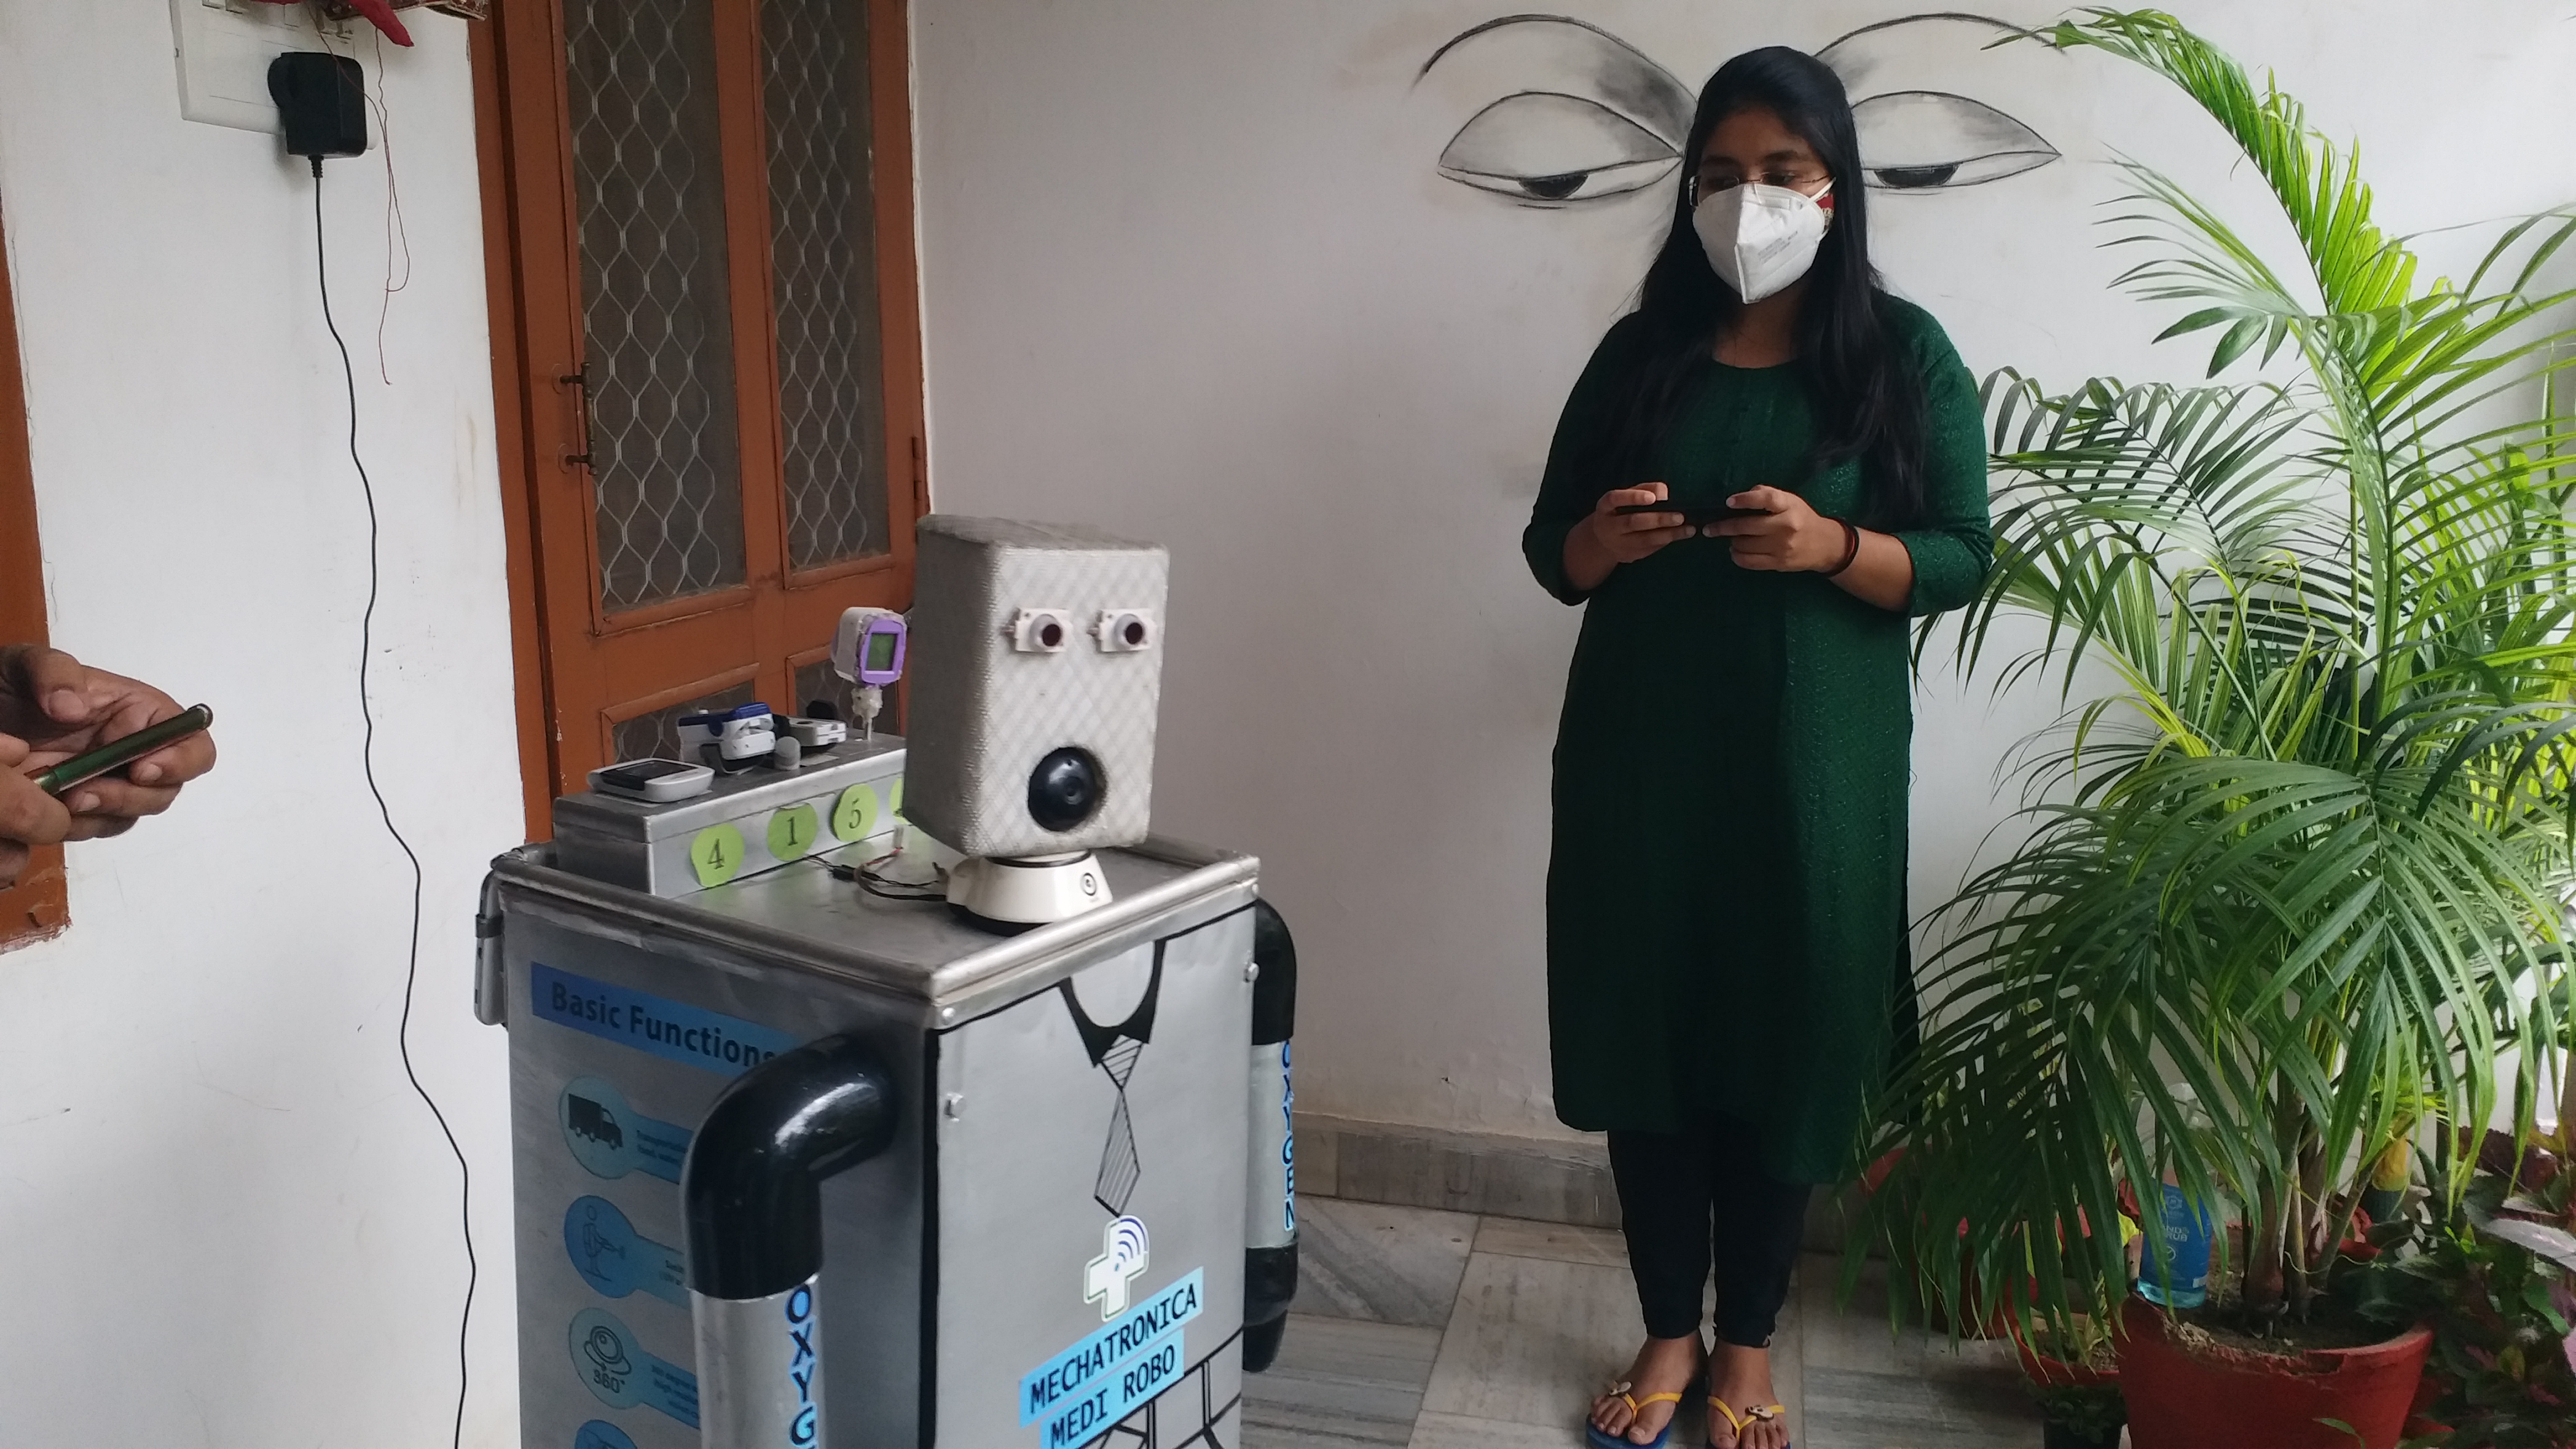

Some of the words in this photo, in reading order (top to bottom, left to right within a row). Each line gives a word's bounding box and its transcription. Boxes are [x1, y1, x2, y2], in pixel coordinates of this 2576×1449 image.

[787, 816, 799, 846] 1
[849, 798, 861, 829] 5
[707, 837, 725, 870] 4
[551, 981, 621, 1029] Basic
[786, 1284, 815, 1449] OXYG
[1030, 1283, 1197, 1414] MECHATRONICA
[1050, 1388, 1108, 1449] MEDI
[1123, 1344, 1175, 1404] ROBO
